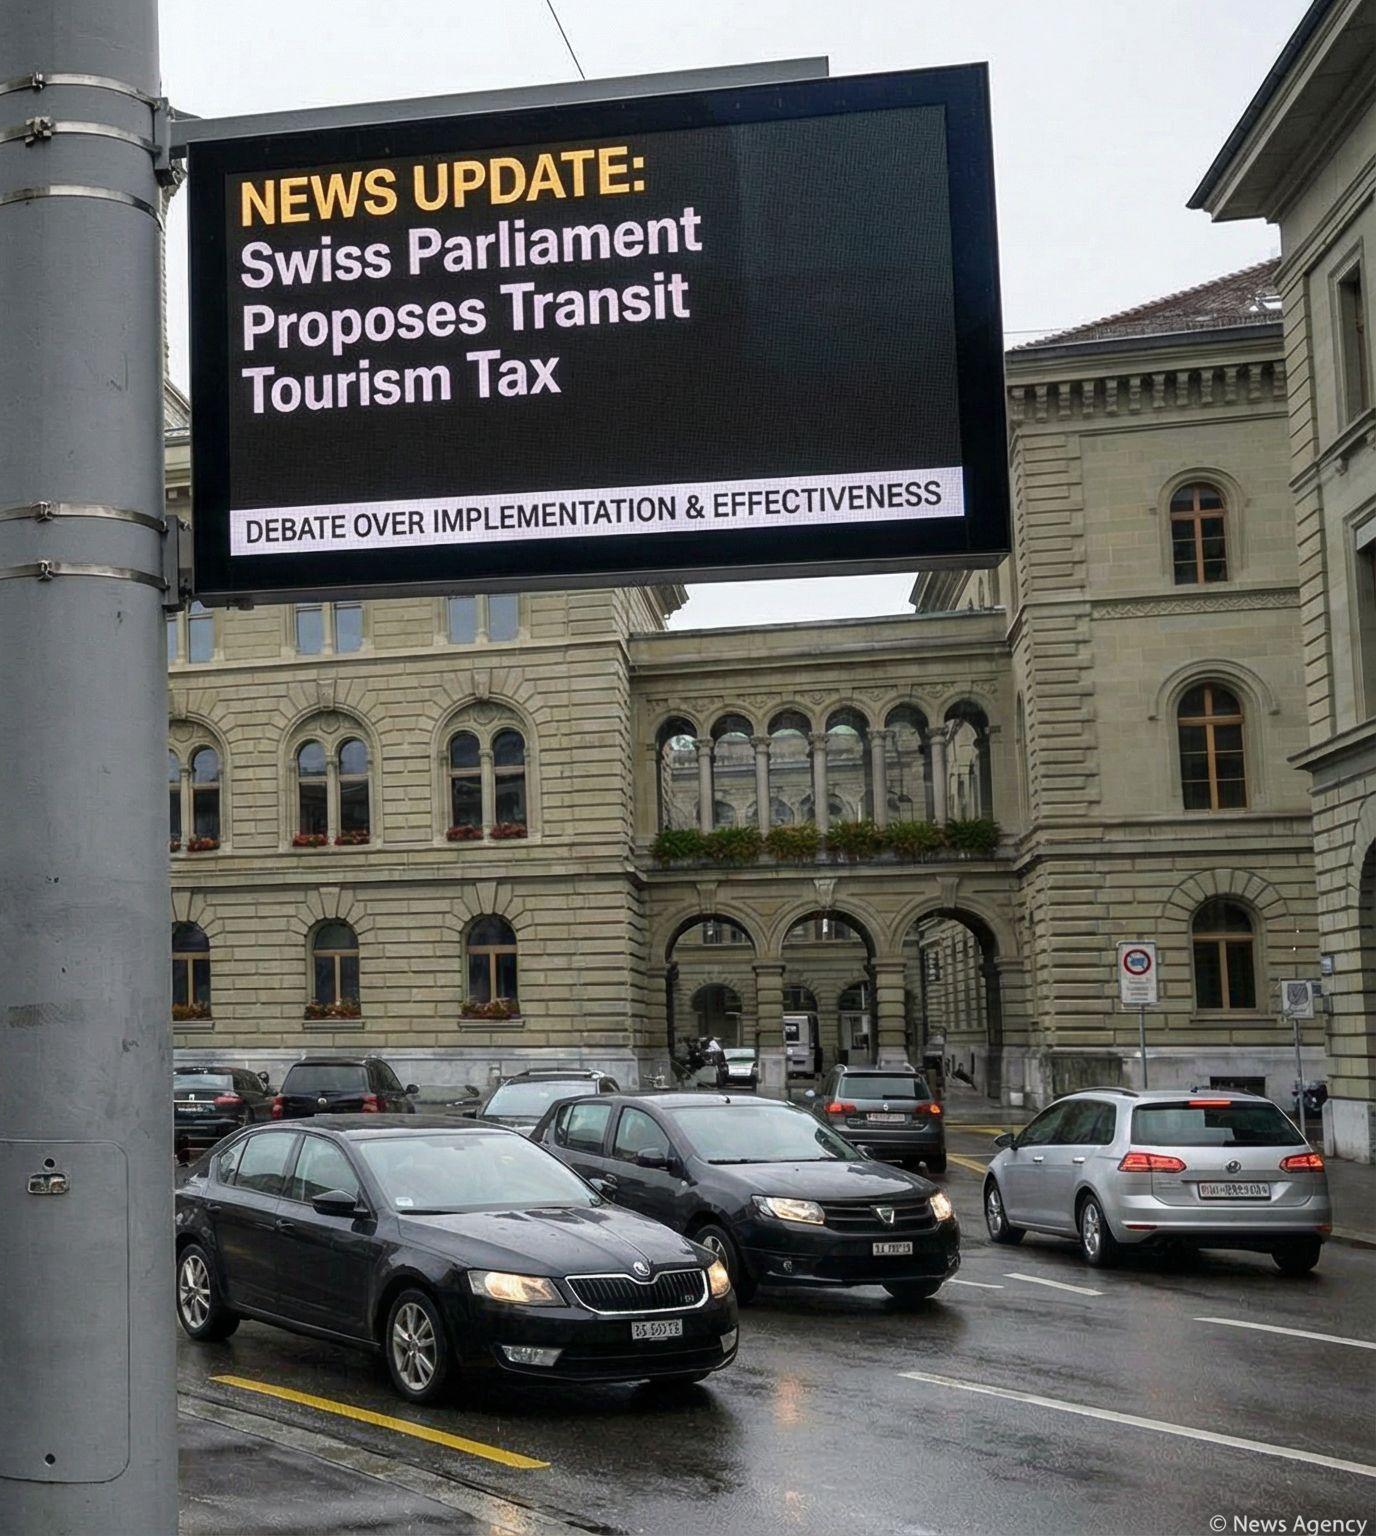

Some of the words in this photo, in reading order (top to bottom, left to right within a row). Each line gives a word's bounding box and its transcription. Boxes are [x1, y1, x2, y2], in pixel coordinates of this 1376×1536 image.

[241, 169, 397, 227] NEWS
[413, 146, 645, 212] UPDATE:
[240, 236, 392, 289] Swiss
[408, 207, 703, 276] Parliament
[242, 298, 486, 356] Proposes
[500, 272, 691, 332] Transit
[241, 360, 451, 414] Tourism
[466, 349, 562, 398] Tax
[246, 515, 346, 544] DEBATE
[353, 511, 425, 538] OVER
[433, 495, 676, 533] IMPLEMENTATION
[684, 494, 706, 520] &
[713, 480, 943, 518] EFFECTIVENESS
